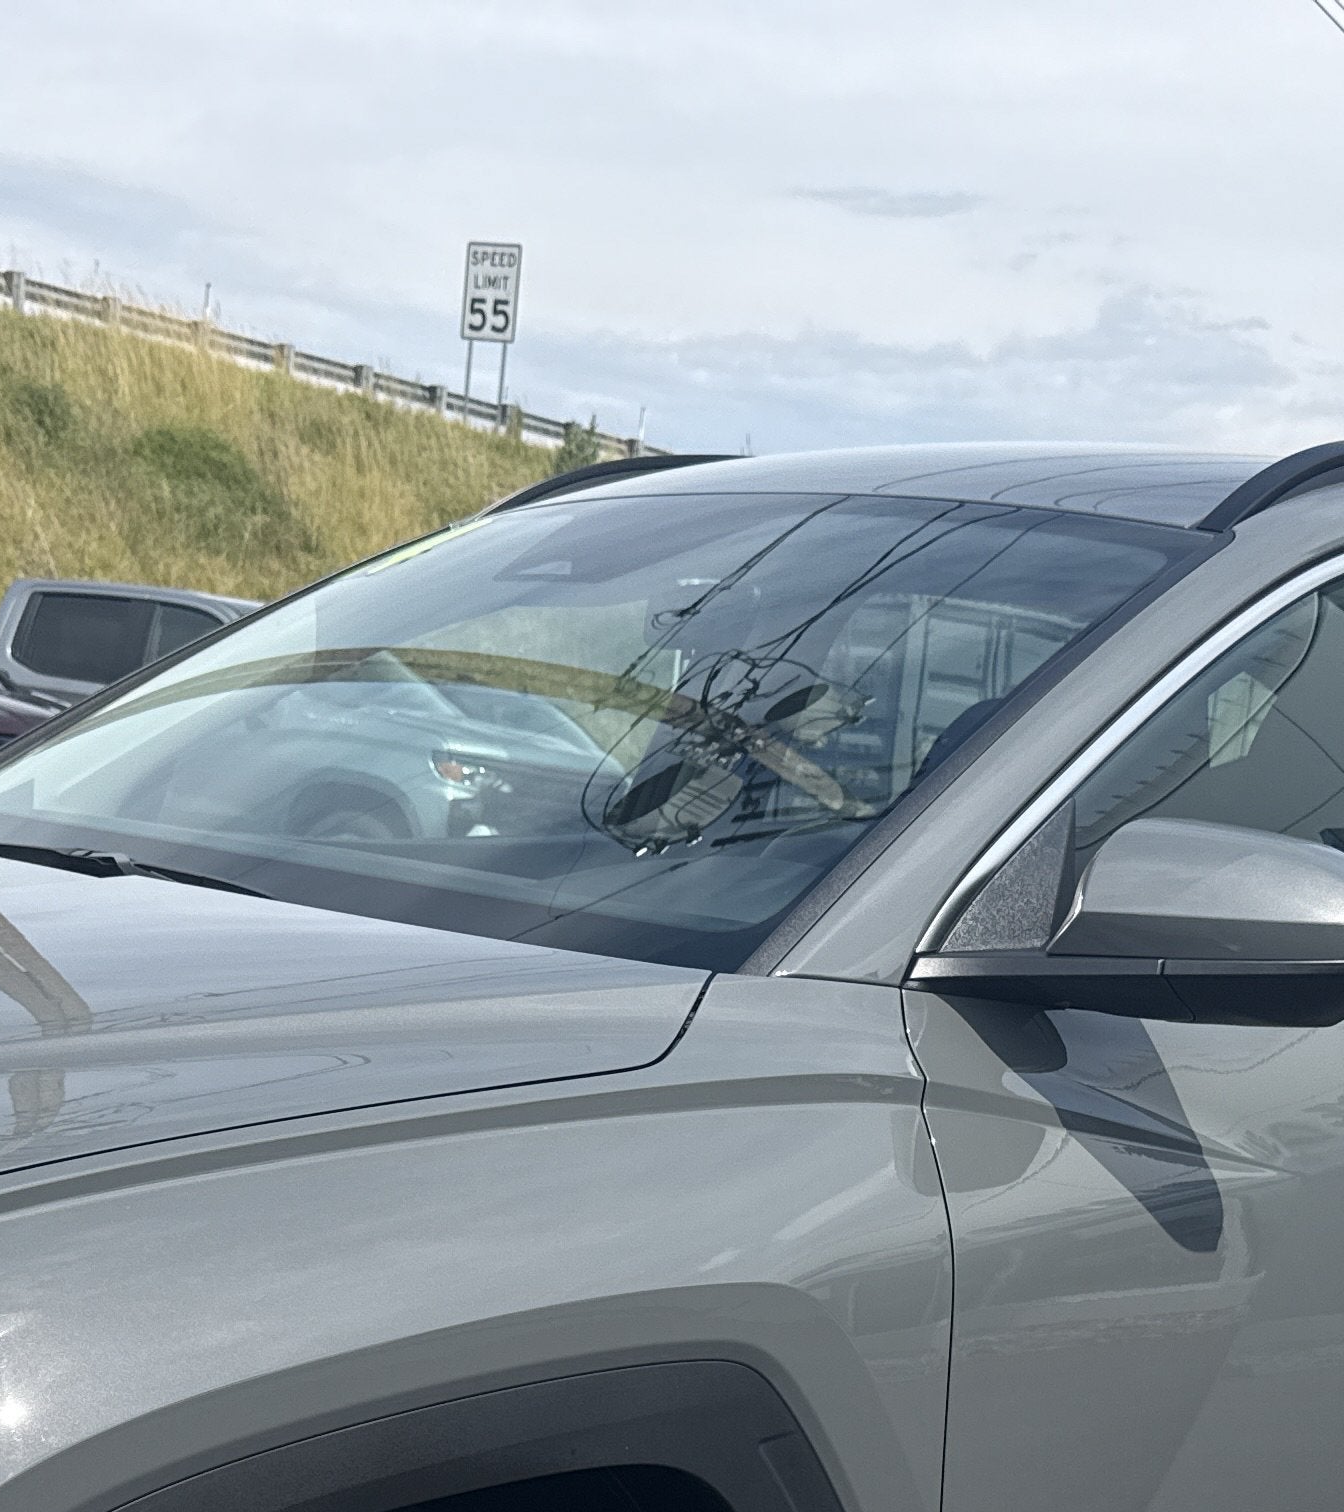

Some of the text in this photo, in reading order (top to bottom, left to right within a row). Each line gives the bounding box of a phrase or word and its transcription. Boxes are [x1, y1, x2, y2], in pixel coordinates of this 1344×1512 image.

[471, 251, 516, 267] SPEED
[474, 274, 509, 289] LIMIT
[468, 298, 510, 332] 55
